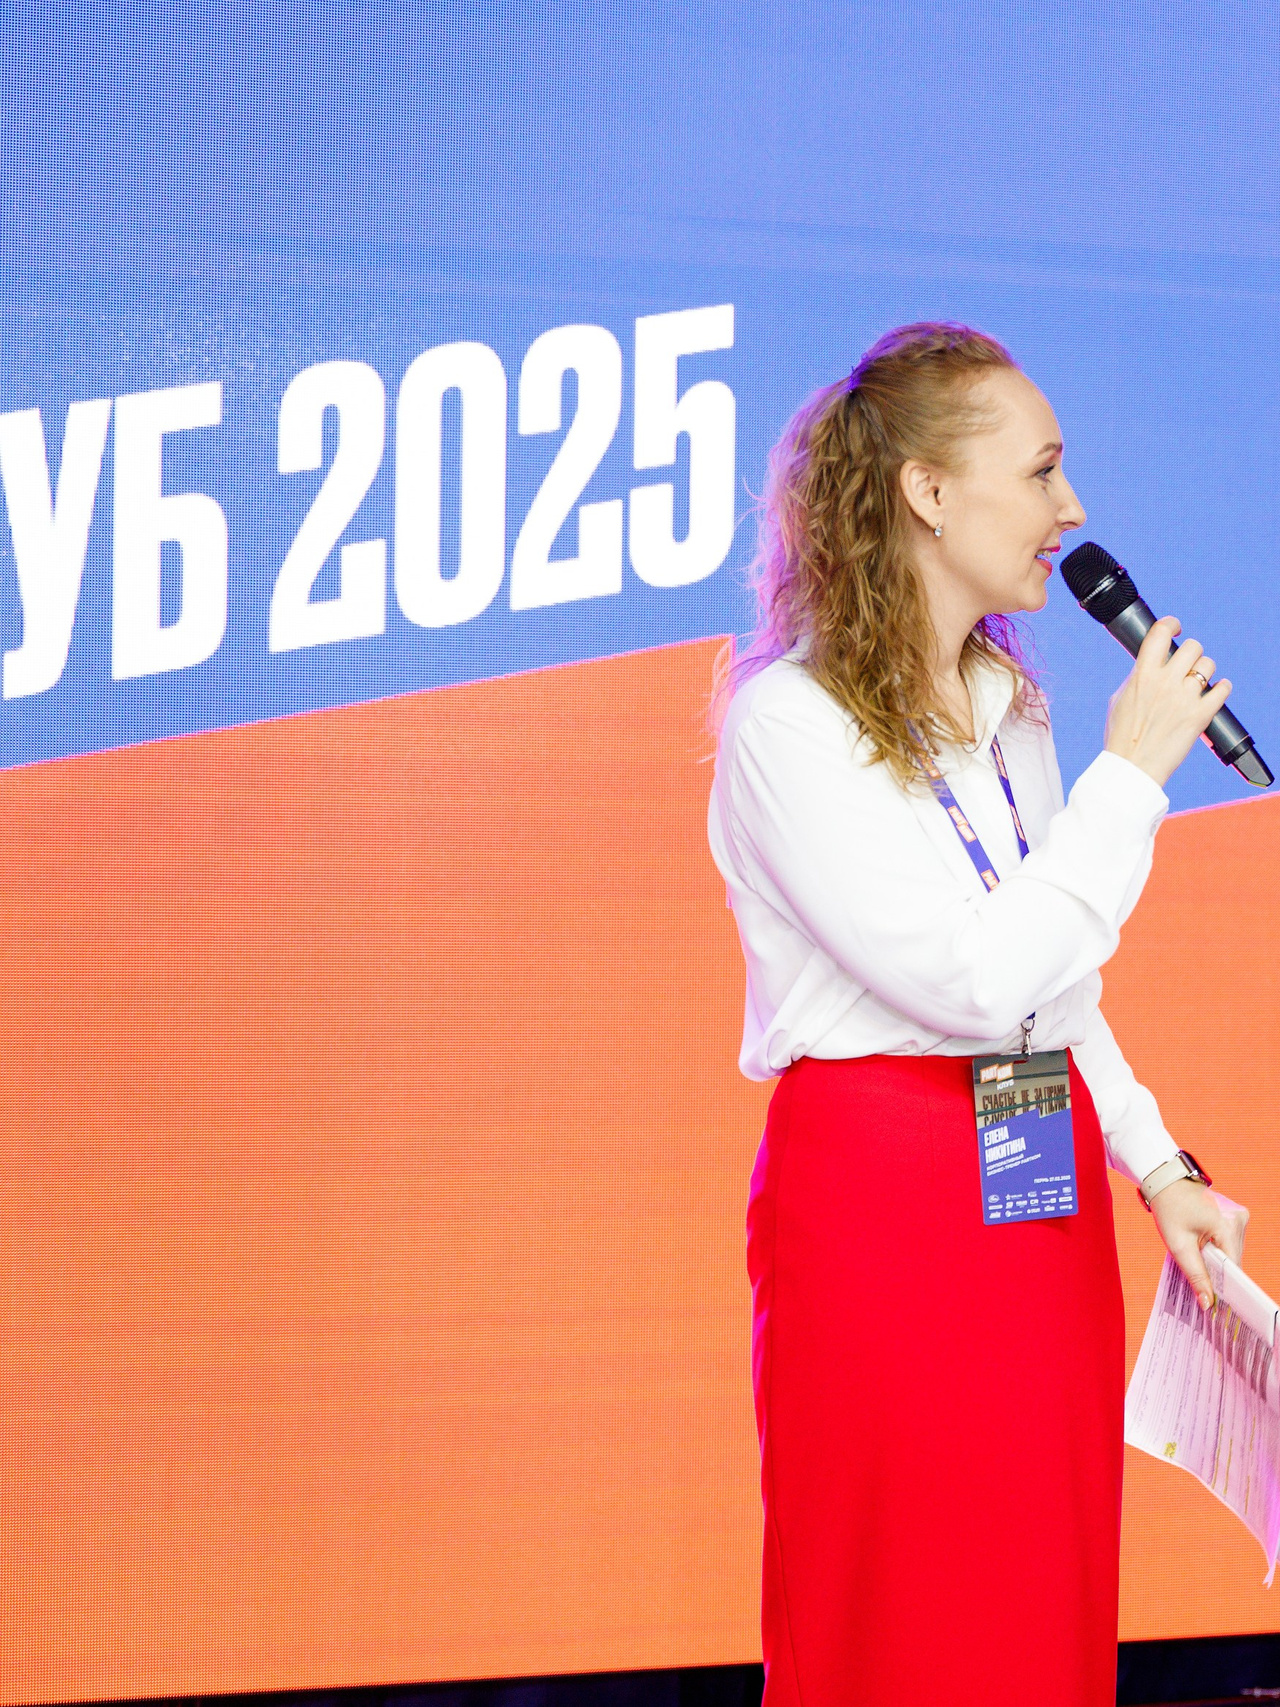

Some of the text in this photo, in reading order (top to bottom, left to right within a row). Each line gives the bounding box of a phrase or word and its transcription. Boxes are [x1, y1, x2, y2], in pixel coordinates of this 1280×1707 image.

[269, 303, 735, 653] 2025
[982, 1091, 1016, 1111] СЧАСТЬЕ
[984, 1125, 1010, 1147] ЕЛЕНА
[985, 1137, 1027, 1164] НИКИТИНА
